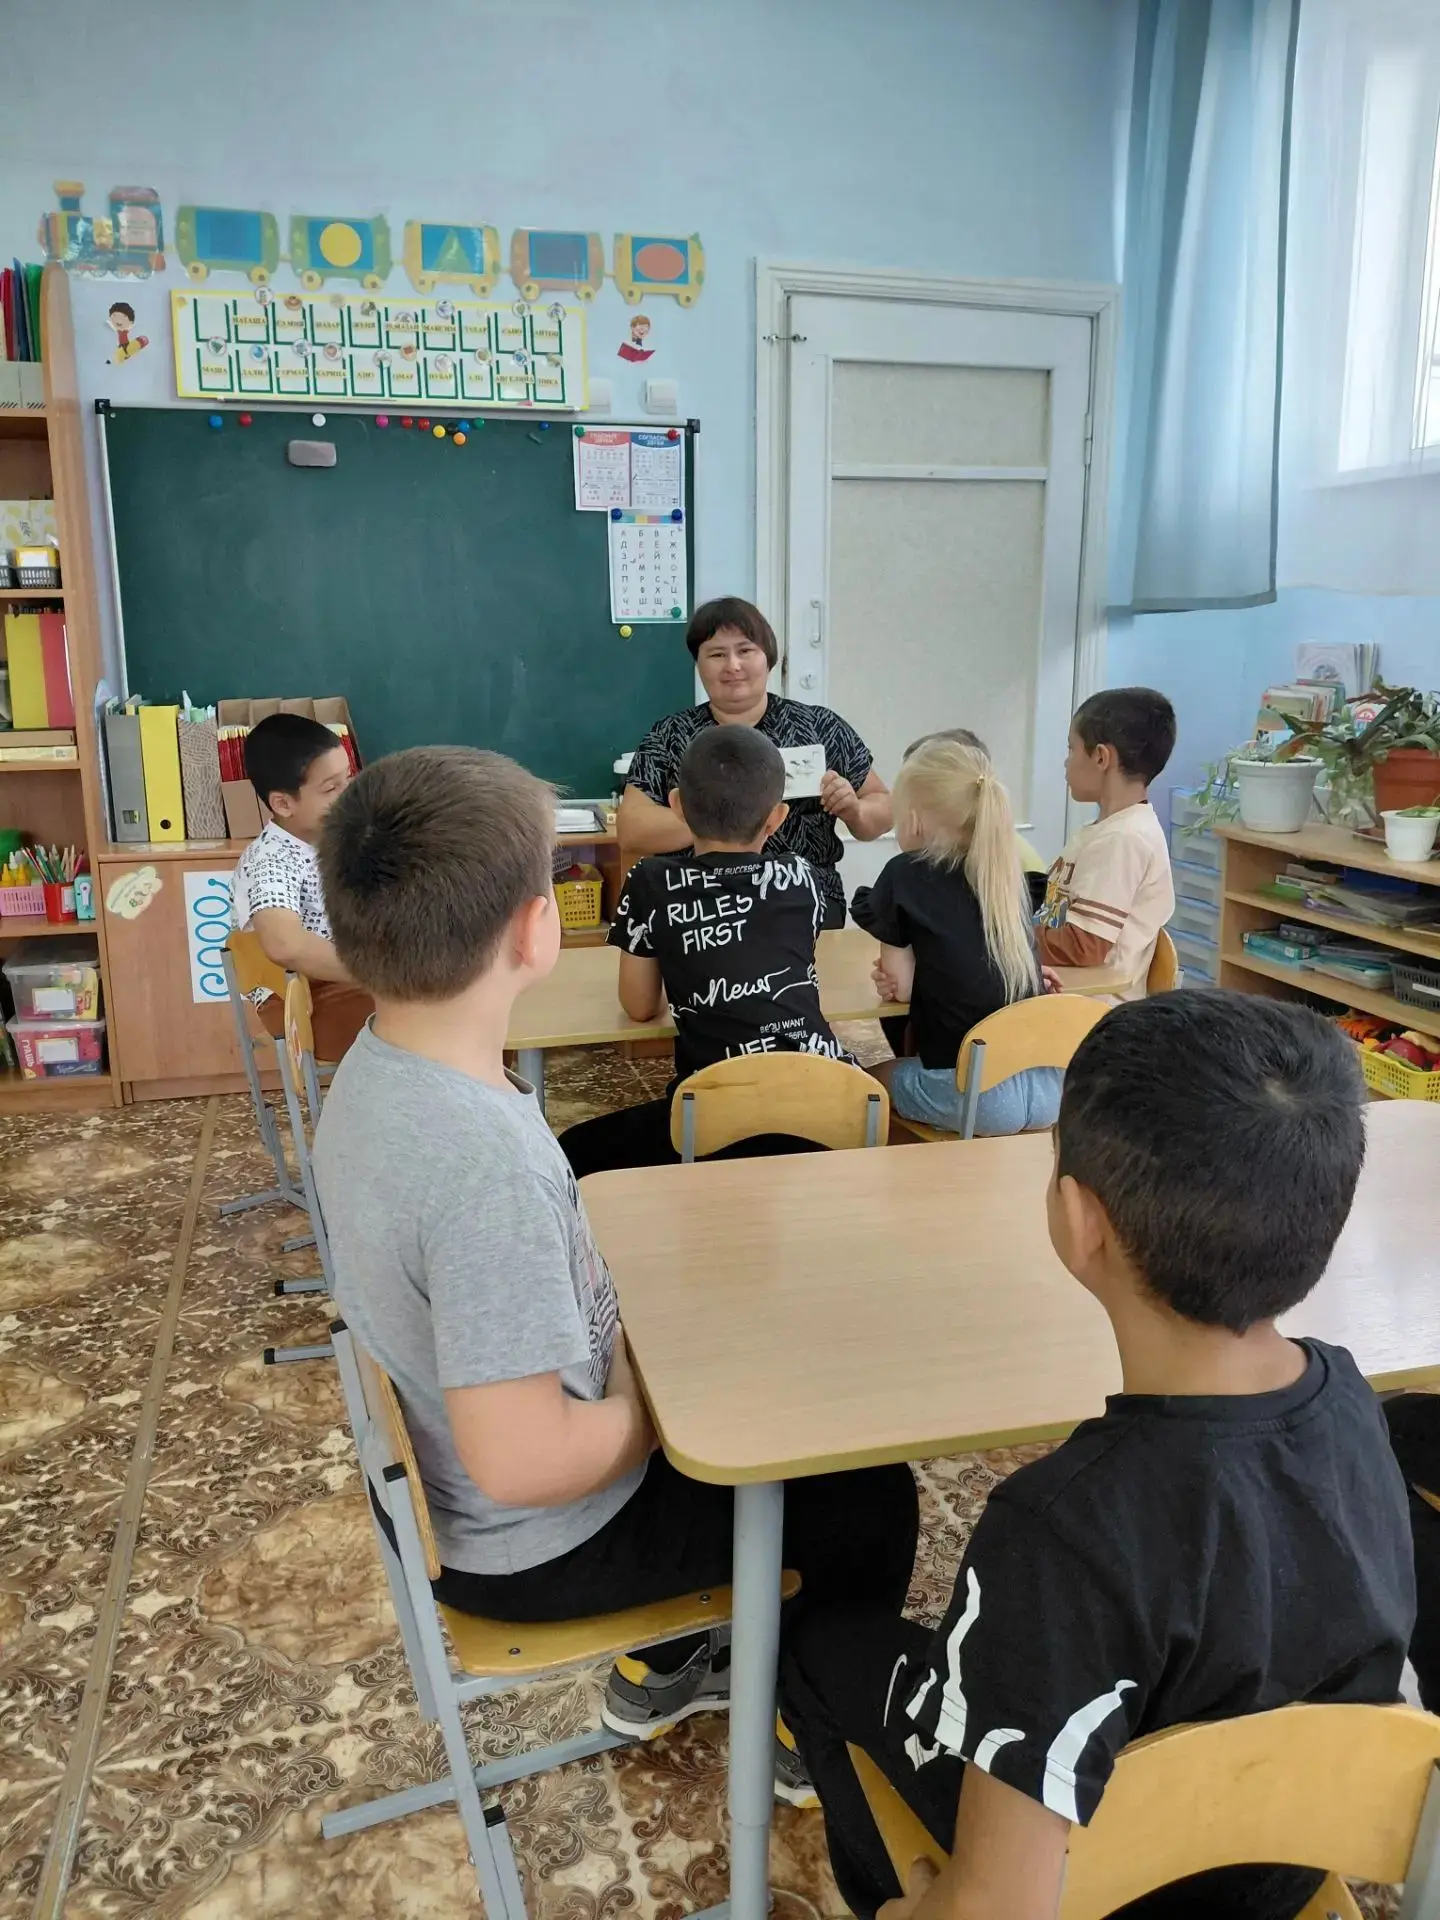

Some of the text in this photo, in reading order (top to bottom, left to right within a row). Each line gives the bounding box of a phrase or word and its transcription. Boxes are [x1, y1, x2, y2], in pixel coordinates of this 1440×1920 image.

[665, 868, 722, 891] LIFE
[713, 867, 724, 876] BE
[667, 894, 753, 926] RULES
[682, 920, 747, 954] FIRST
[782, 1017, 805, 1029] WANT
[21, 1039, 36, 1068] ГУАШЬ
